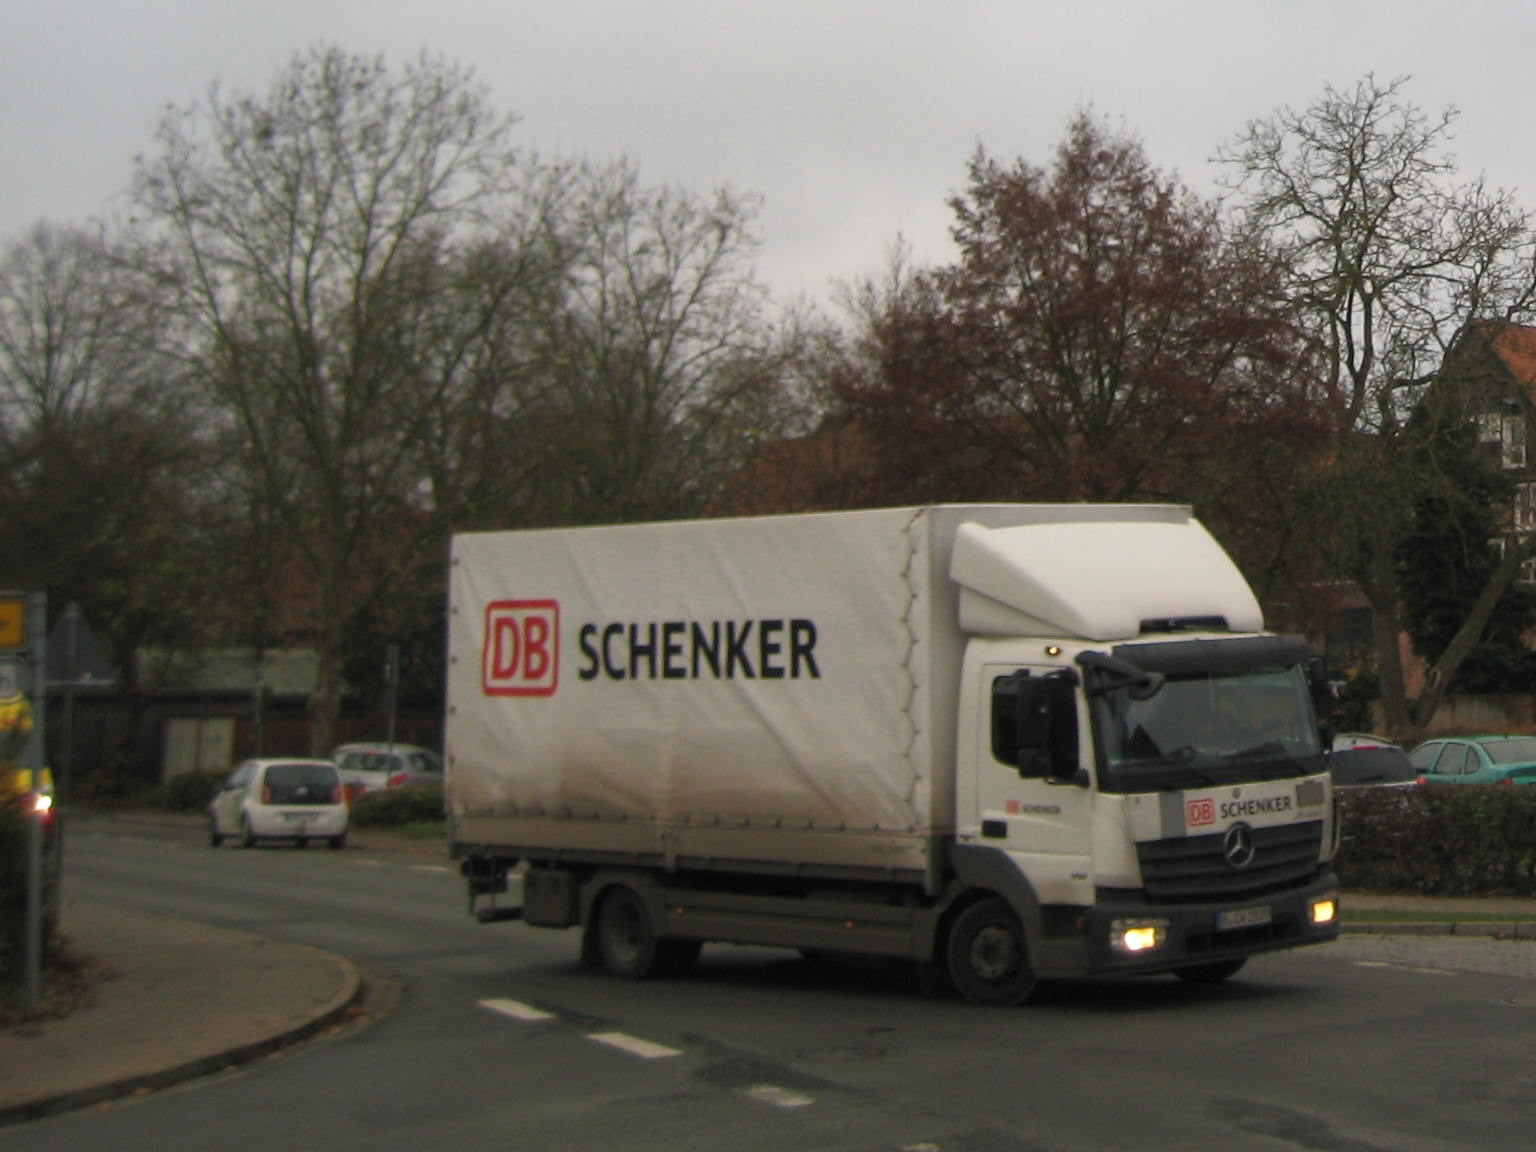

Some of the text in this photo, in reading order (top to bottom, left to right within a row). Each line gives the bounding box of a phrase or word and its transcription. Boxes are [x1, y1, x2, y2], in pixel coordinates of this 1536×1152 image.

[491, 616, 821, 681] DB SCHENKER
[1190, 803, 1212, 824] DB
[1220, 796, 1292, 819] SCHENKER
